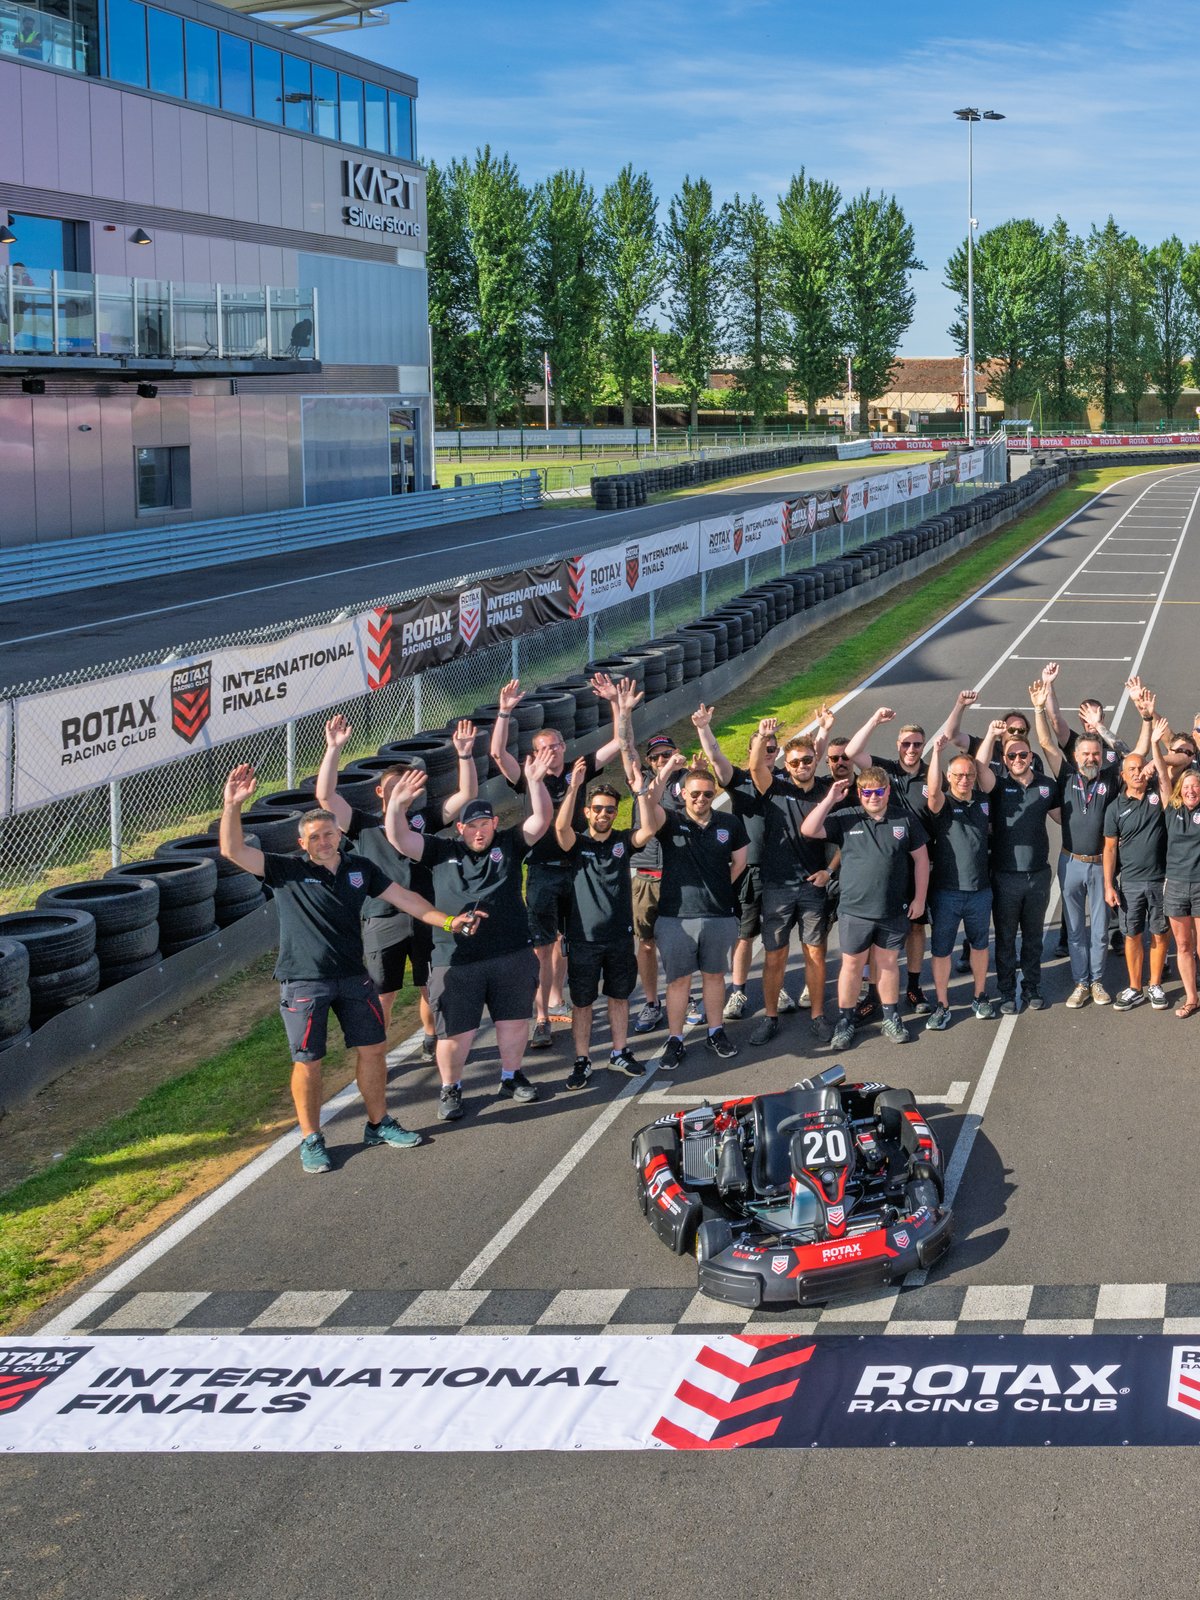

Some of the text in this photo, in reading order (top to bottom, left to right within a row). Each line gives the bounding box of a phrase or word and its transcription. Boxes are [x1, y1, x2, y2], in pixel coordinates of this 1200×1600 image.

[348, 160, 419, 210] KART
[349, 206, 421, 237] Silverstone
[874, 442, 897, 450] ROTAX
[907, 441, 932, 449] ROTAX
[709, 529, 731, 548] ROTAX
[641, 541, 689, 564] INTERNATIONAL
[590, 562, 622, 587] ROTAX
[641, 561, 665, 577] FINALS
[461, 591, 480, 606] ROTAX
[486, 579, 563, 612] INTERNATIONAL
[591, 579, 622, 596] RACING CLUB
[401, 609, 452, 646] ROTAX
[486, 605, 524, 628] FINALS
[401, 632, 452, 658] RACING CLUB
[172, 664, 210, 687] ROTAX
[222, 641, 355, 693] INTERNATIONAL
[172, 678, 210, 693] RACING CLUB
[222, 681, 288, 715] FINALS
[61, 695, 157, 750] ROTAX
[60, 727, 157, 766] RACING CLUB
[803, 1129, 847, 1165] 20
[732, 1251, 762, 1262] birelart
[822, 1242, 861, 1258] ROTAX
[823, 1251, 862, 1263] RACING
[88, 1366, 622, 1388] INTERNATIONAL
[854, 1363, 1122, 1396] ROTAX
[56, 1392, 312, 1415] FINALS
[846, 1397, 1118, 1413] RACING CLUB
